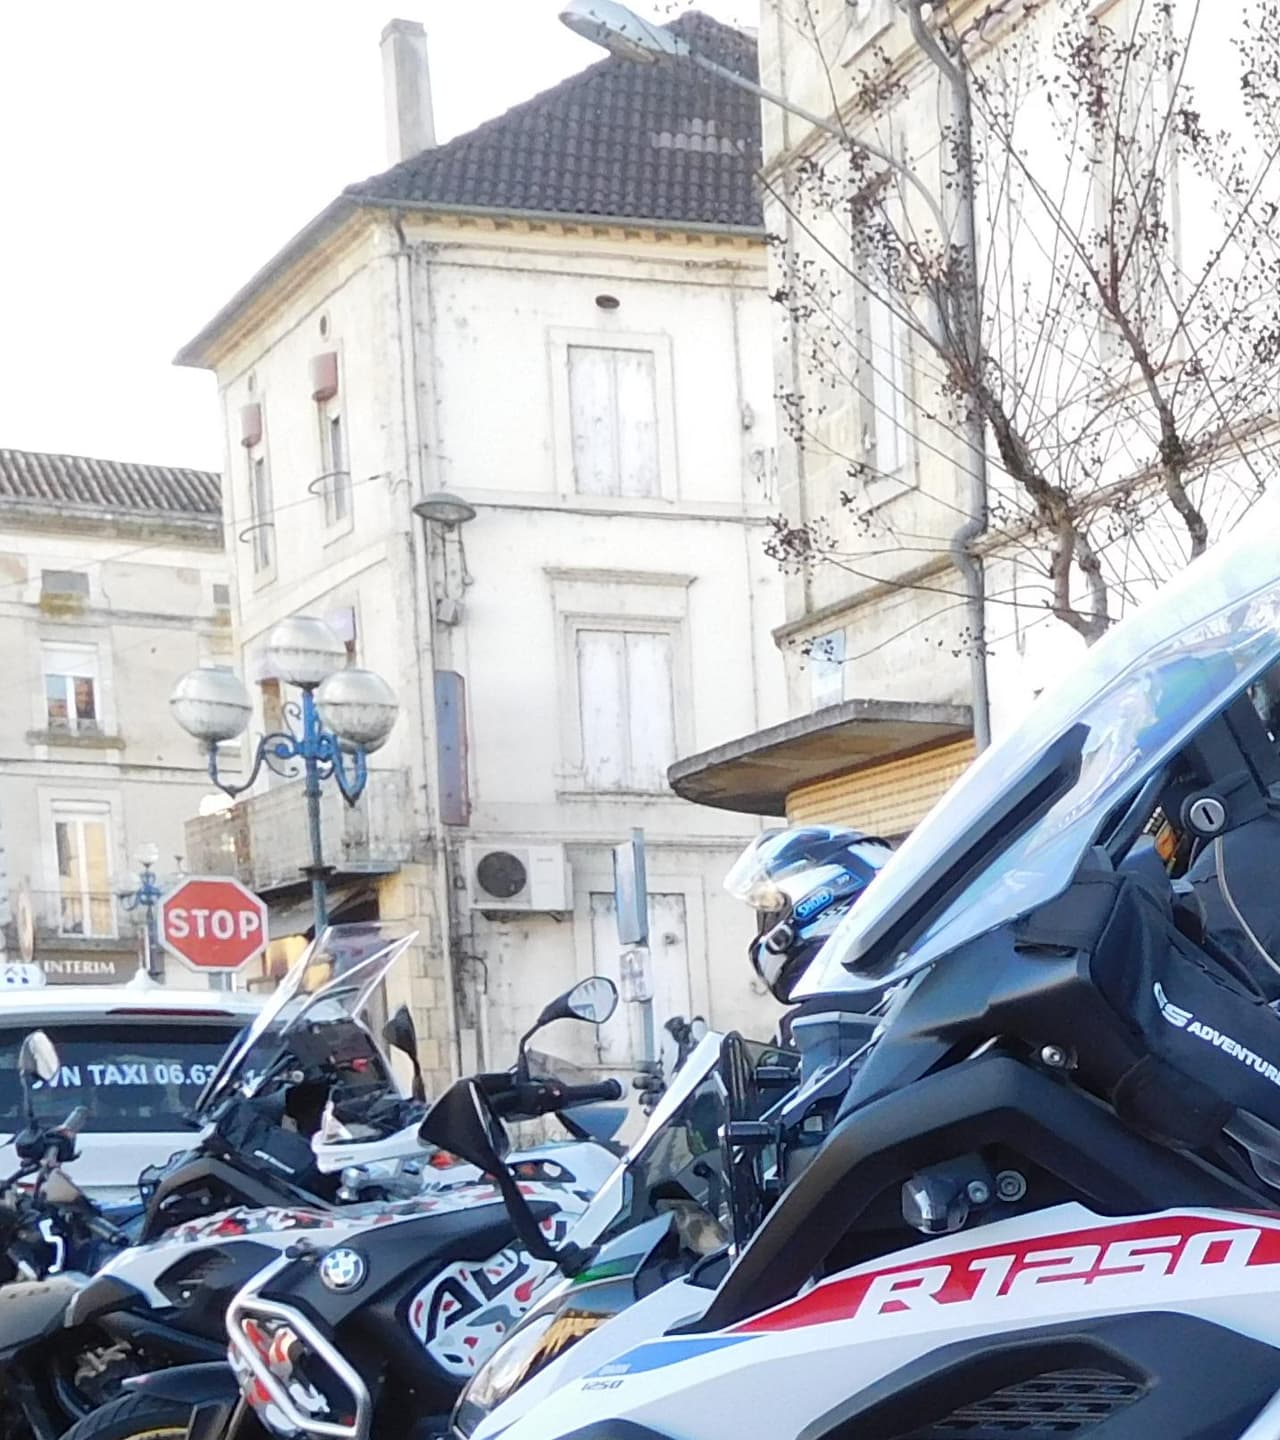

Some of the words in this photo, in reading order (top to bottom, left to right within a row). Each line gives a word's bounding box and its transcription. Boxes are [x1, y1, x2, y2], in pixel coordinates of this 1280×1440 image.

[167, 908, 260, 940] STOP
[43, 960, 116, 975] INTERIM
[87, 1064, 149, 1085] TAXI
[855, 1265, 951, 1319] R
[968, 1228, 1262, 1303] 1250
